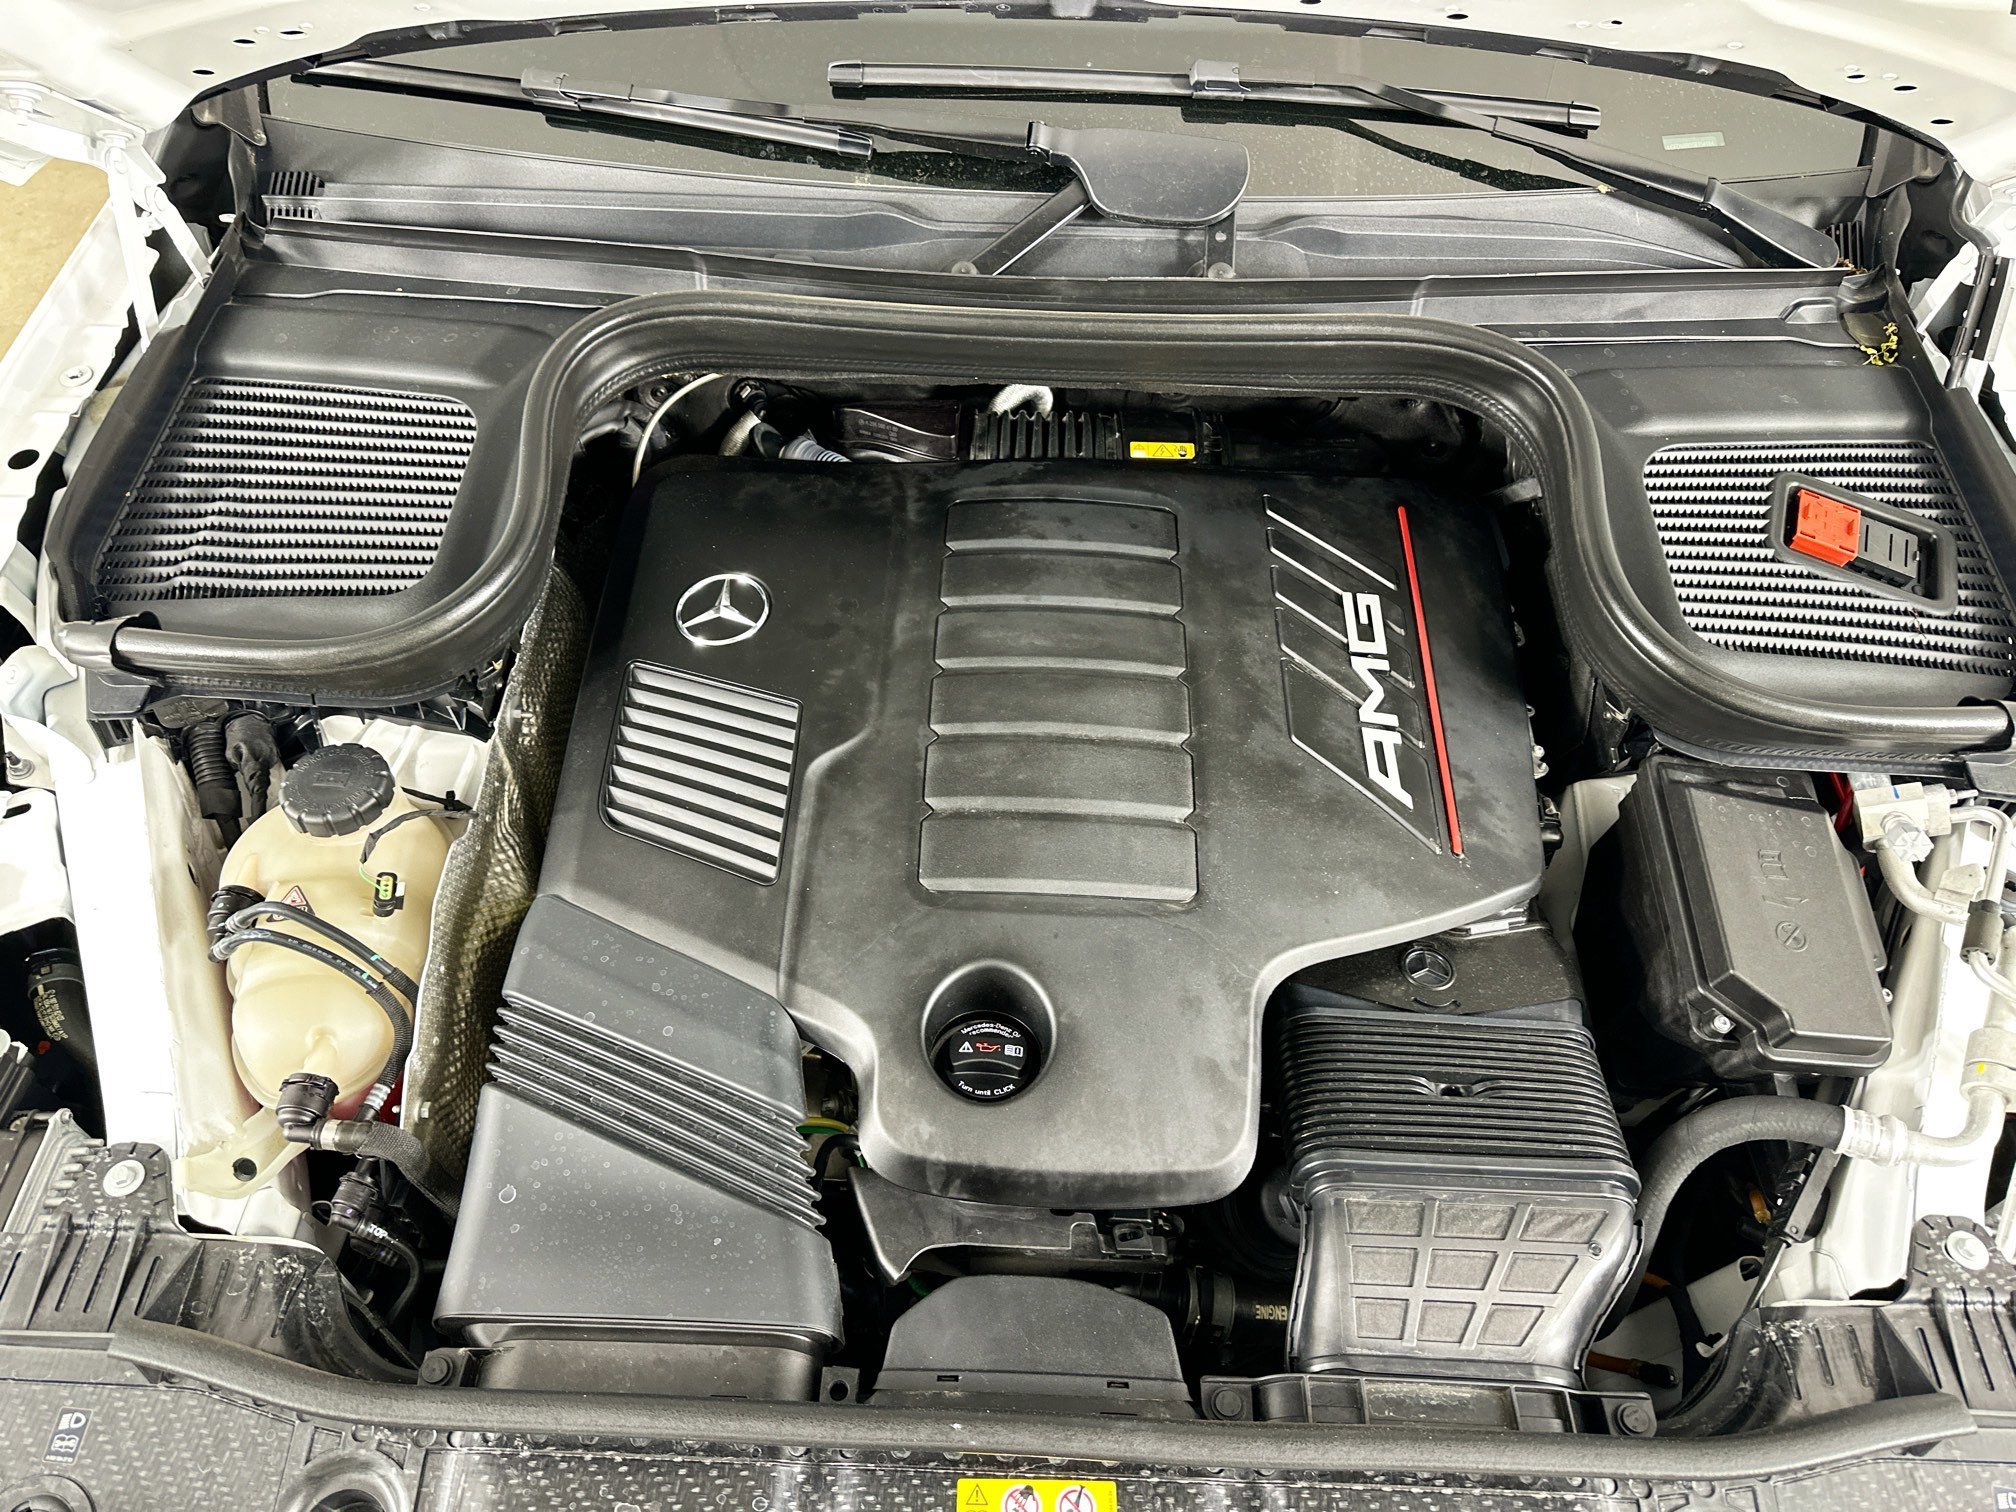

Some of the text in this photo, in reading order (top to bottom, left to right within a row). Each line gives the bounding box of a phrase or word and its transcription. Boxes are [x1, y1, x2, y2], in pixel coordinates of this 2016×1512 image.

[1341, 591, 1414, 811] AMG
[309, 751, 326, 764] NOT
[960, 1022, 1013, 1035] Mercedes-Benz
[958, 1080, 1016, 1096] Turn until CLICK
[369, 1223, 389, 1239] TOP
[1255, 1304, 1289, 1321] ENGINE
